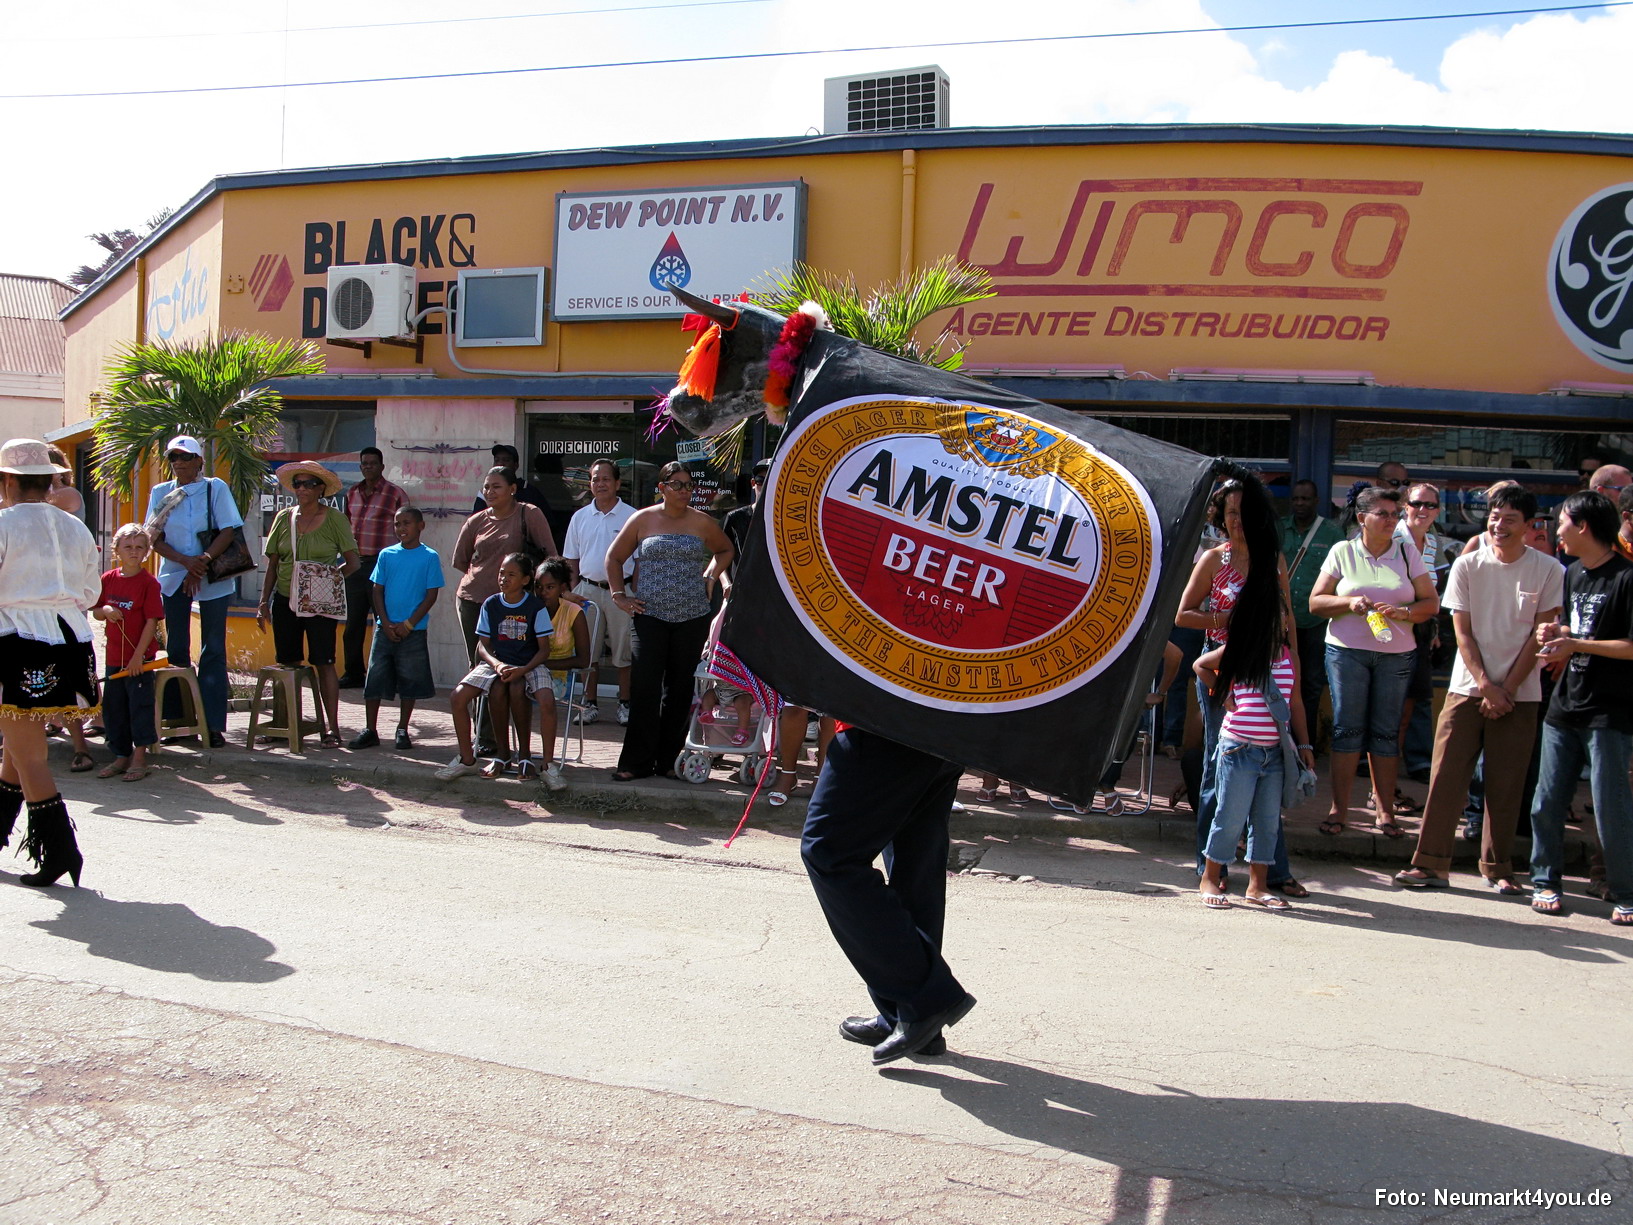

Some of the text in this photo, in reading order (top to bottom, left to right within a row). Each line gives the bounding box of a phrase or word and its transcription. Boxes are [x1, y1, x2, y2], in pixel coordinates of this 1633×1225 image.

[568, 193, 784, 231] DEW POINT N.V.
[568, 296, 623, 309] SERVICE
[627, 296, 639, 308] IS
[643, 295, 671, 307] OUR
[942, 307, 1097, 336] AGENTE
[832, 410, 927, 441] LAGER
[540, 441, 619, 454] DIRECTORS
[678, 442, 701, 455] CLOSED
[932, 459, 1034, 496] QUALITY PRODUCT
[1072, 463, 1129, 519] BEER
[847, 449, 1081, 568] AMSTEL
[786, 439, 1138, 688] BREWED TO THE AMSTEL TRADITION
[882, 533, 1006, 606] BEER
[906, 586, 965, 614] LAGER
